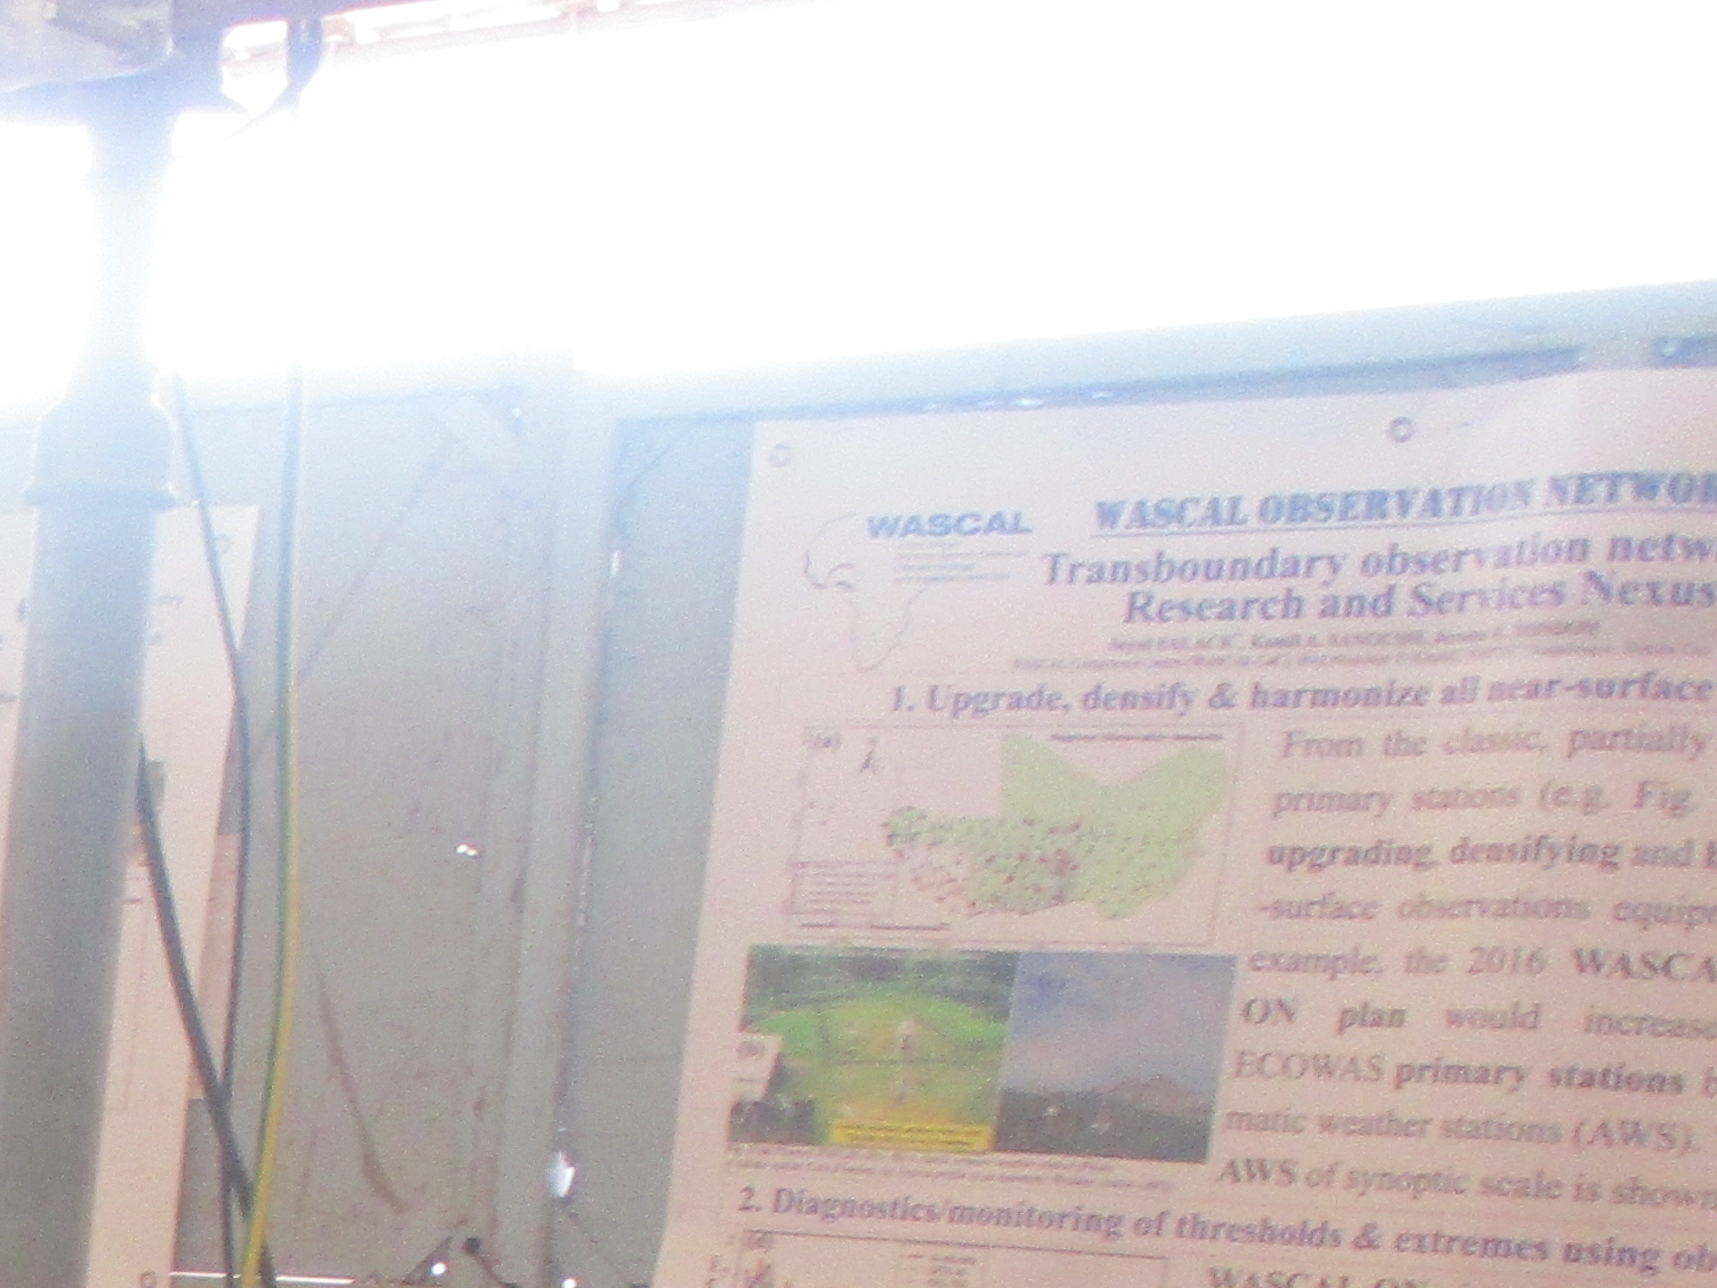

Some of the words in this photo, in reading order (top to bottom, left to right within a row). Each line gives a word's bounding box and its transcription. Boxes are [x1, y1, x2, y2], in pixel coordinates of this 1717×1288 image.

[866, 510, 1033, 539] WASCAL
[1094, 495, 1248, 531] WASCAL
[1258, 478, 1536, 526] OBSERVATION
[1042, 546, 1348, 586] Transboundary
[1360, 531, 1591, 578] observation
[1607, 531, 1717, 564] netw
[1123, 588, 1304, 622] Research
[1318, 583, 1397, 619] and
[1407, 577, 1567, 618] Services
[891, 685, 915, 712] 1.
[927, 683, 1071, 719] Upgrade,
[1082, 682, 1194, 718] densify
[1208, 683, 1236, 711] &
[1250, 681, 1429, 710] harmonize
[1439, 676, 1480, 705] all
[1487, 671, 1714, 704] near-surface
[1282, 729, 1364, 758] From
[1383, 727, 1428, 757] the
[1566, 722, 1709, 762] partially
[1270, 785, 1392, 819] primary
[1411, 783, 1522, 812] stations
[1449, 833, 1622, 871] densifying
[1630, 838, 1695, 868] and
[1258, 890, 1380, 921] -surface
[1396, 892, 1590, 922] observations
[1249, 946, 1384, 981] example,
[1404, 946, 1449, 974] the
[1467, 947, 1547, 975] 2016
[1241, 997, 1298, 1027] ON
[1336, 1000, 1406, 1036] plan
[1444, 1001, 1543, 1032] would
[1233, 1048, 1385, 1083] ECOWAS
[1393, 1056, 1532, 1094] primary
[1547, 1061, 1685, 1096] stations
[1225, 1106, 1307, 1135] matic
[1317, 1108, 1431, 1138] weather
[1439, 1110, 1563, 1145] stations
[1572, 1117, 1701, 1158] (AWS).
[1217, 1156, 1298, 1187] AWS
[1304, 1159, 1341, 1190] of
[1343, 1165, 1469, 1200] synoptic
[1479, 1169, 1562, 1200] scale
[1572, 1171, 1602, 1204] is
[737, 1185, 762, 1214] 2.
[771, 1186, 1125, 1242] Diagnostics/monitoring
[1134, 1206, 1170, 1237] of
[1175, 1212, 1343, 1250] thresholds
[1352, 1221, 1382, 1251] &
[1394, 1228, 1550, 1263] extremes
[1563, 1236, 1664, 1277] using
